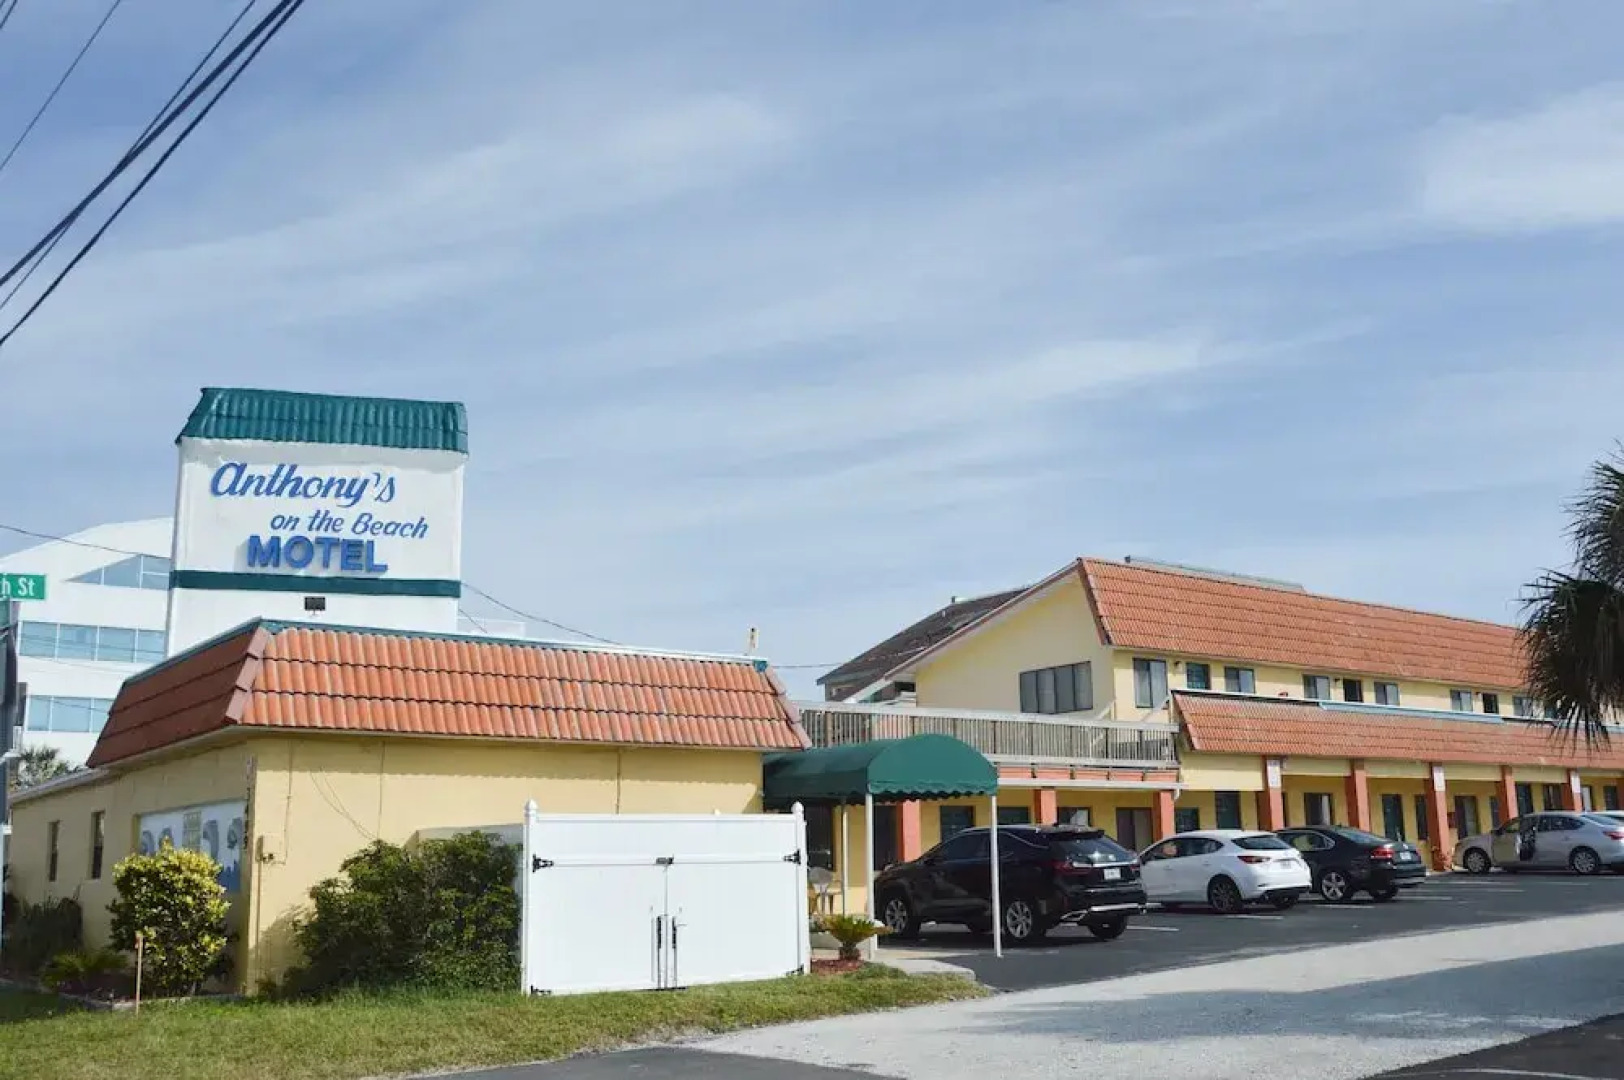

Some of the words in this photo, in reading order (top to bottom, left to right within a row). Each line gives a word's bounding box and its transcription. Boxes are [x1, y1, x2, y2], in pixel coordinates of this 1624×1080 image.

[210, 461, 396, 508] Anthony's
[270, 514, 300, 531] on
[307, 510, 343, 532] the
[351, 512, 429, 538] Beach
[247, 534, 389, 573] MOTEL
[17, 577, 35, 596] St
